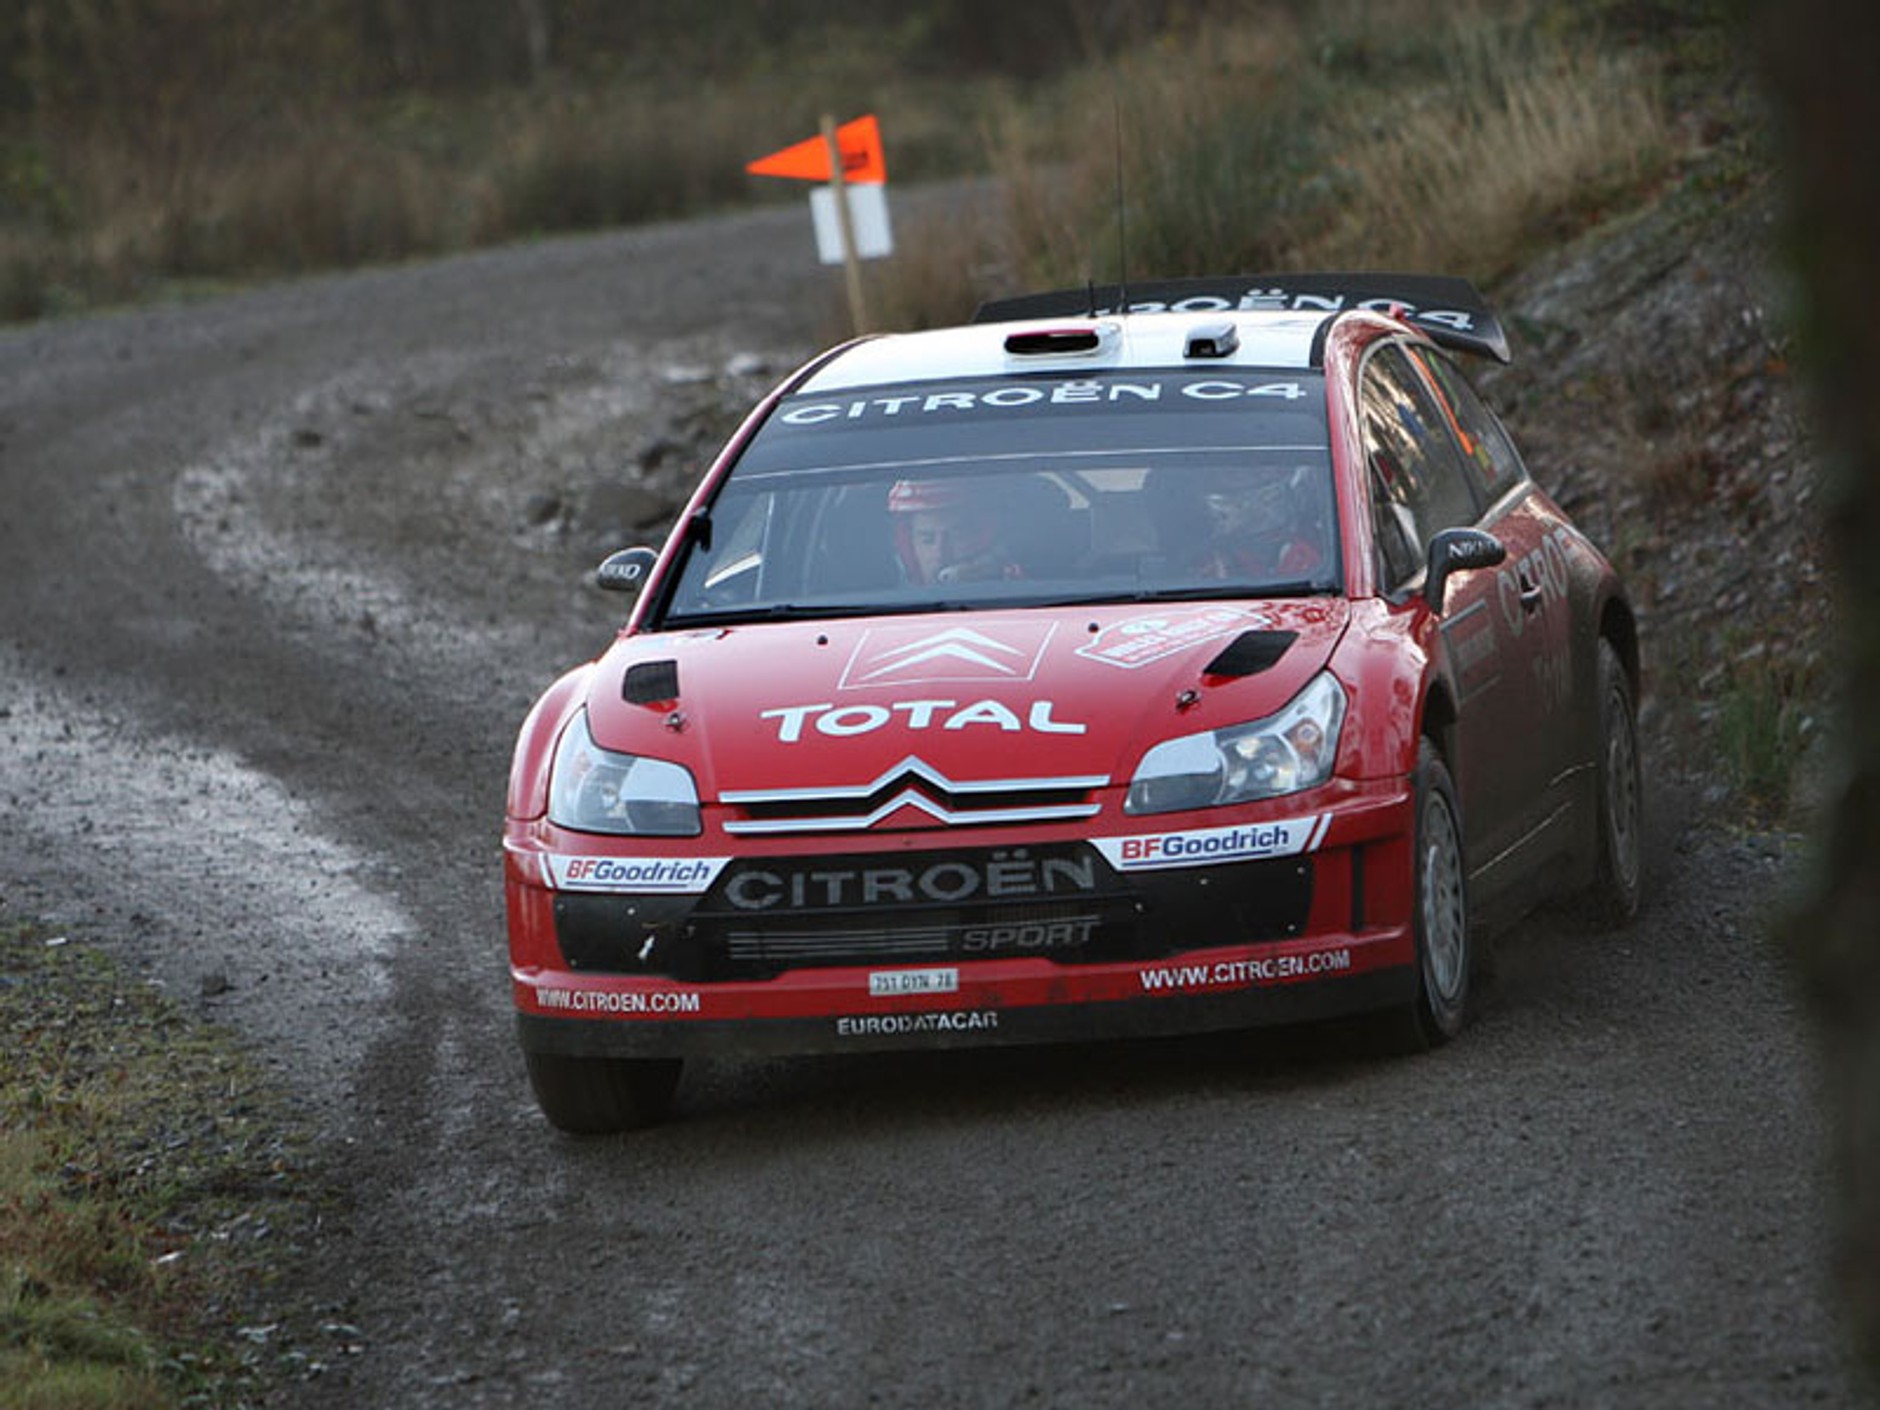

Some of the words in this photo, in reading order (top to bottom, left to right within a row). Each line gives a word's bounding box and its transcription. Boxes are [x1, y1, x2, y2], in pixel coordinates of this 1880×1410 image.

[781, 379, 1162, 425] CITROËN
[1181, 380, 1306, 401] C4
[760, 699, 1087, 743] TOTAL
[1121, 826, 1289, 859] BFGoodrich
[565, 859, 710, 882] BFGoodrich
[724, 848, 1095, 910] CITROËN
[962, 920, 1097, 952] SPORT
[1140, 949, 1350, 990] WWW.CITROEN.COM
[536, 986, 700, 1012] WWW.CITROEN.COM
[838, 1011, 998, 1036] EURODATACAR
